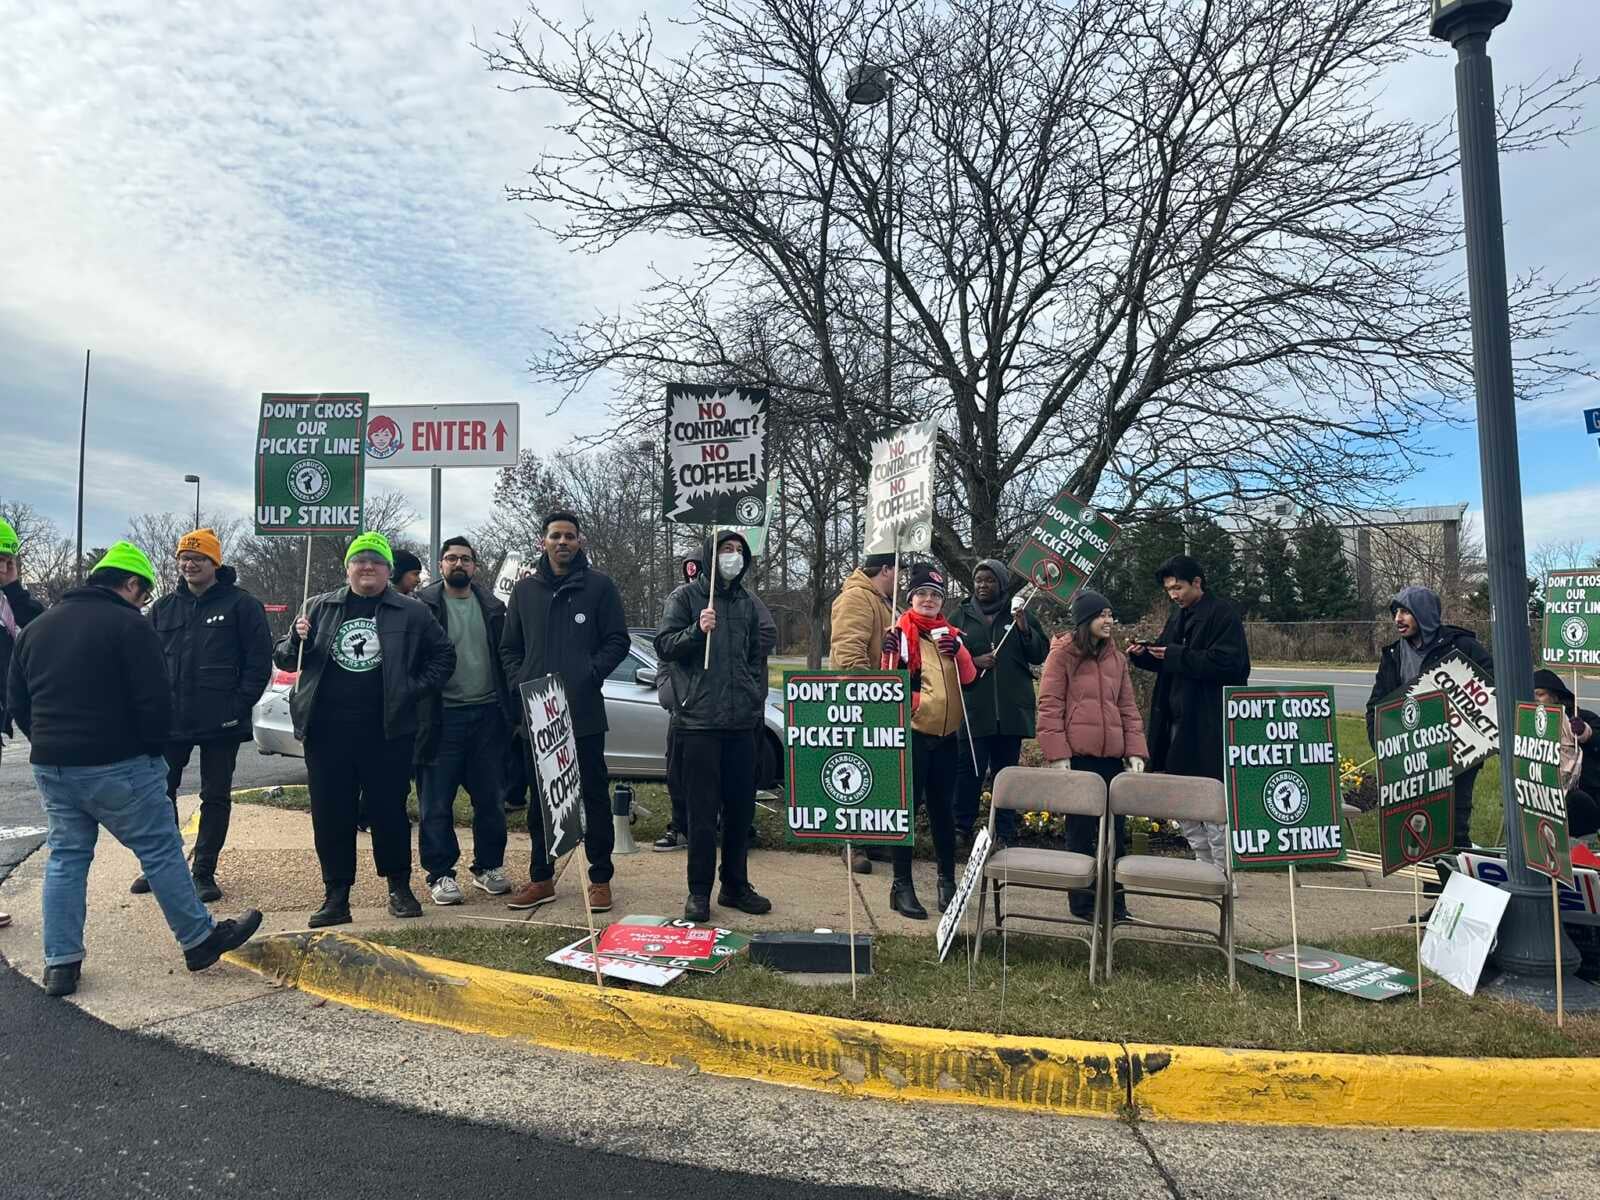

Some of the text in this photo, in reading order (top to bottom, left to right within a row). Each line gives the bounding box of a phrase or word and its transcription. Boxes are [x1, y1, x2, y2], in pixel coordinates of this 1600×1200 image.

[263, 402, 363, 418] DON'T CROSS
[698, 402, 727, 420] NO
[297, 421, 327, 436] OUR
[412, 421, 487, 451] ENTER
[674, 414, 760, 442] CONTRACT?
[259, 438, 361, 455] PICKET LINE
[701, 443, 730, 463] NO
[889, 440, 905, 459] NO
[679, 453, 757, 488] COFFEE!
[874, 445, 928, 480] CONTRACT?
[890, 477, 905, 496] NO
[876, 481, 925, 521] COFFEE!
[257, 505, 360, 525] ULP STRIKE
[1046, 505, 1080, 530] DON'T
[1077, 525, 1110, 553] CROSS
[1060, 529, 1083, 550] OUR
[1031, 526, 1073, 557] PICKET
[1070, 551, 1096, 576] LINE
[1548, 575, 1600, 588] DON'T CROS
[1566, 589, 1586, 600] OUR
[1545, 602, 1600, 614] PICKET LIN
[339, 621, 377, 635] STARBUC
[1543, 648, 1600, 664] ULP STRIK
[787, 683, 905, 702] DON'T CROSS
[1463, 679, 1489, 706] NO
[543, 696, 560, 722] NO
[827, 705, 864, 723] OUR
[1227, 698, 1331, 719] DON'T CROSS
[787, 726, 905, 748] PICKET LINE
[1265, 722, 1299, 740] OUR
[1377, 732, 1409, 761] DON'T
[1412, 722, 1451, 746] CROSS
[556, 745, 570, 772] NO
[1228, 742, 1334, 766] PICKET LINE
[1514, 734, 1561, 766] BARISTAS
[828, 755, 866, 770] STARBUCKS
[1403, 751, 1429, 776] OUR
[1528, 761, 1542, 783] ON
[825, 776, 870, 801] WORKERS UNITED
[1269, 773, 1303, 788] STARBUCKS
[1380, 773, 1425, 807] PICKET
[1428, 765, 1454, 792] LINE
[1266, 797, 1289, 821] WORKERS
[1515, 778, 1566, 818] STRIKE!
[788, 807, 909, 832] ULP STRIKE
[1232, 825, 1342, 854] ULP STRIKE
